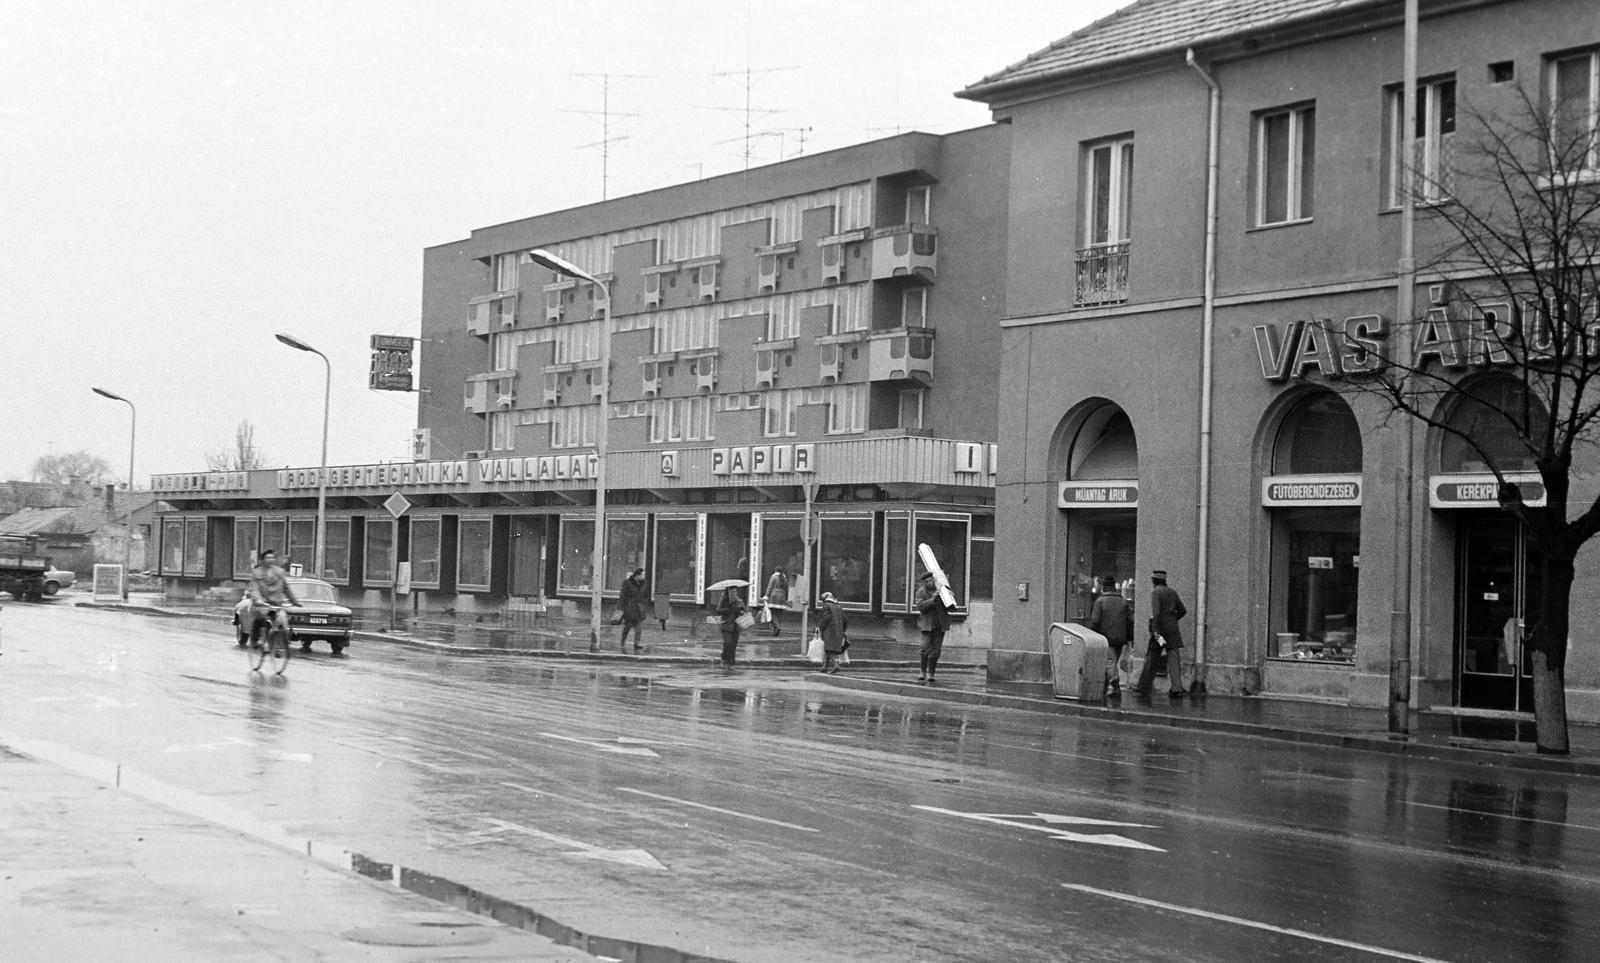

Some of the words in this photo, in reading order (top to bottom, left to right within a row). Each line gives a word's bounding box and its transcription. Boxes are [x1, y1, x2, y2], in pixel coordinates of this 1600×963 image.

[1253, 313, 1387, 380] VAS
[280, 463, 464, 488] IRODGÉPTECHNIKA
[1457, 482, 1501, 500] KERÉKPÁ
[291, 565, 301, 576] T
